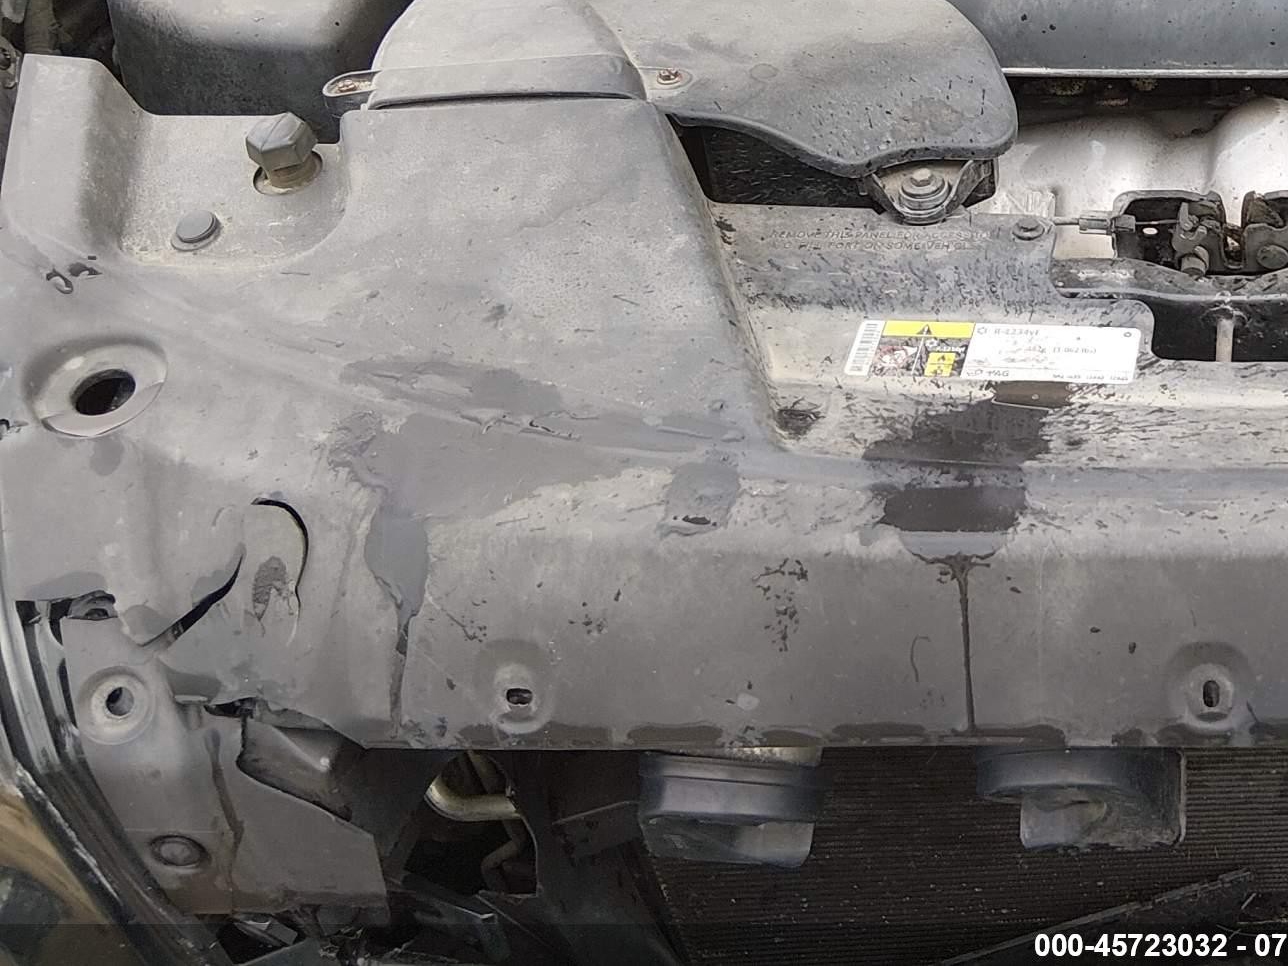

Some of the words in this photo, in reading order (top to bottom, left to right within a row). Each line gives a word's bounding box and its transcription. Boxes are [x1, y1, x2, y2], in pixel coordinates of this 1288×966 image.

[769, 229, 821, 239] REMOVE
[824, 230, 852, 240] THIS
[854, 231, 894, 240] PANEL
[886, 241, 921, 251] SOME
